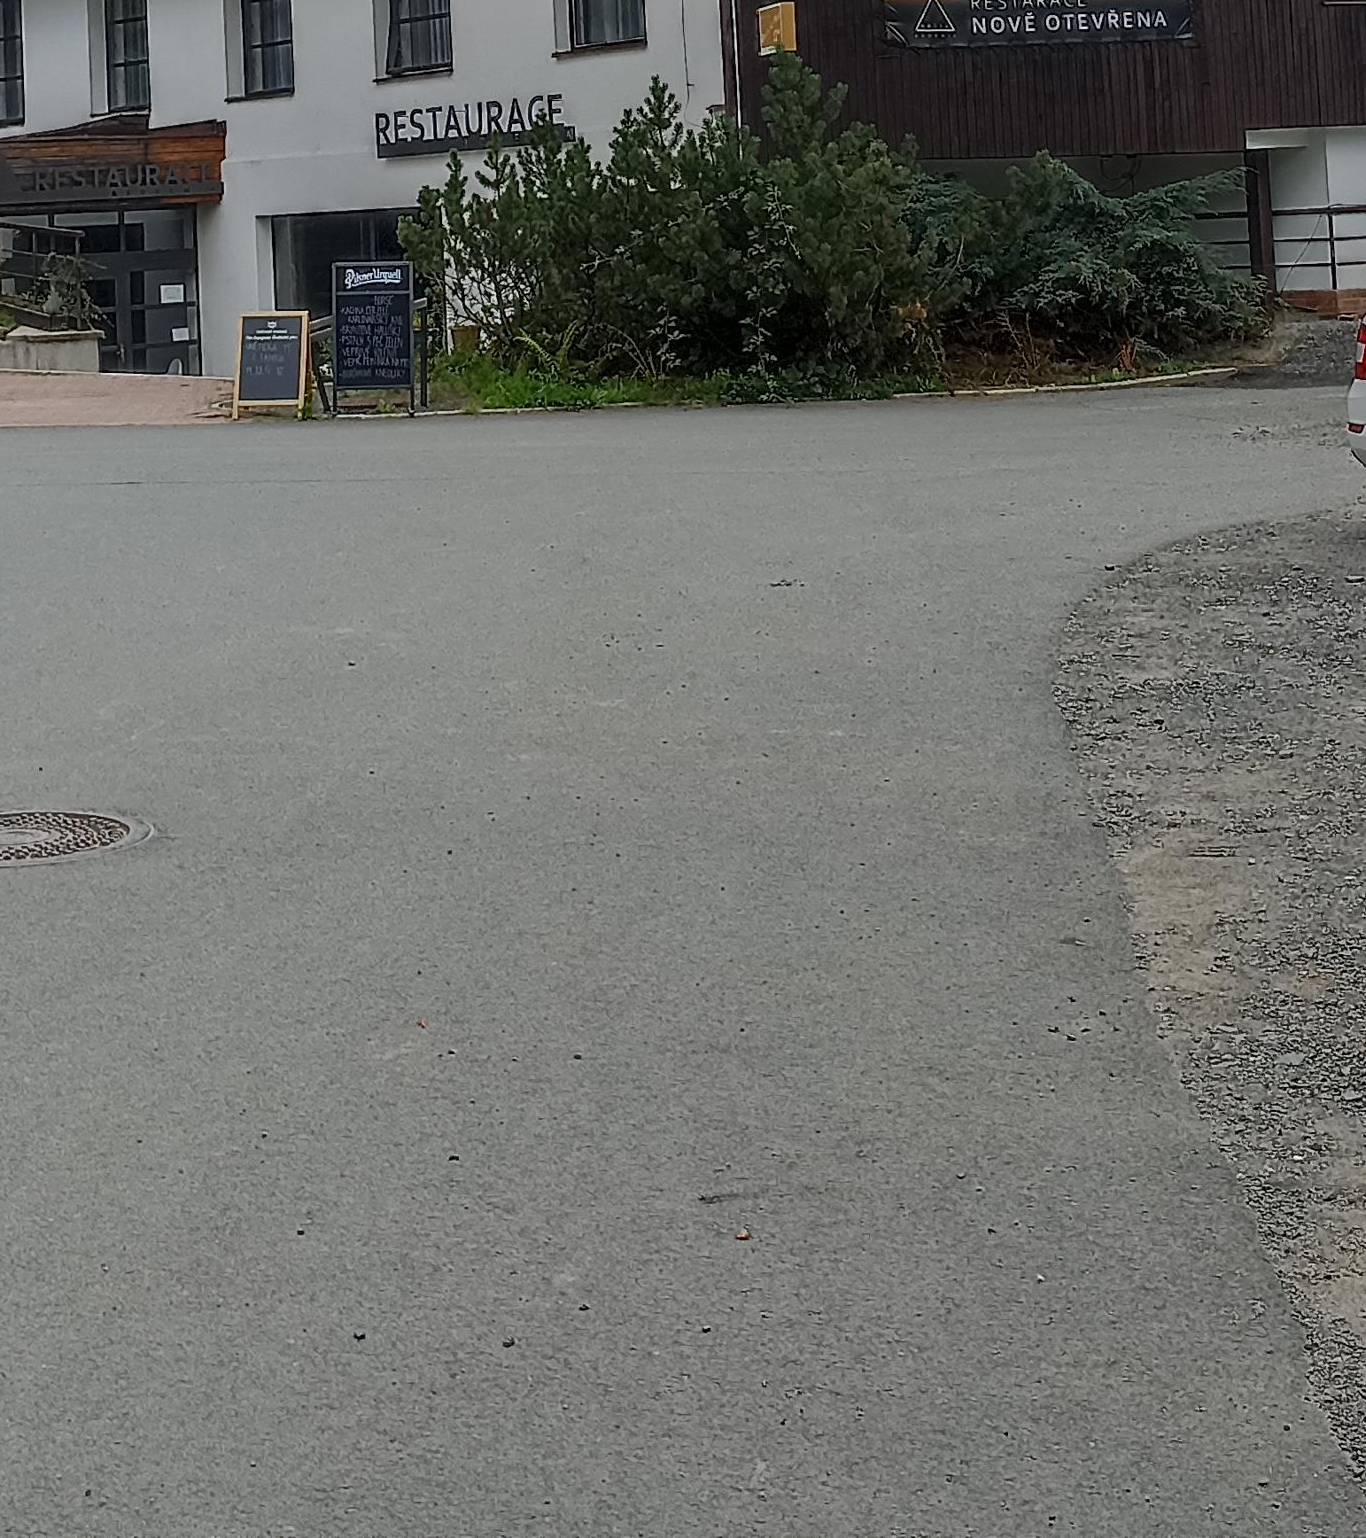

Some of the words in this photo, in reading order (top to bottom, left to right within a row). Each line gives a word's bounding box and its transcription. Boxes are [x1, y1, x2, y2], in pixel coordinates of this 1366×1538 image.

[972, 11, 1036, 34] NOVĚ
[1045, 9, 1168, 31] OTEVŘENA
[375, 93, 565, 145] RESTAURACE
[35, 164, 211, 191] RESTAURACE
